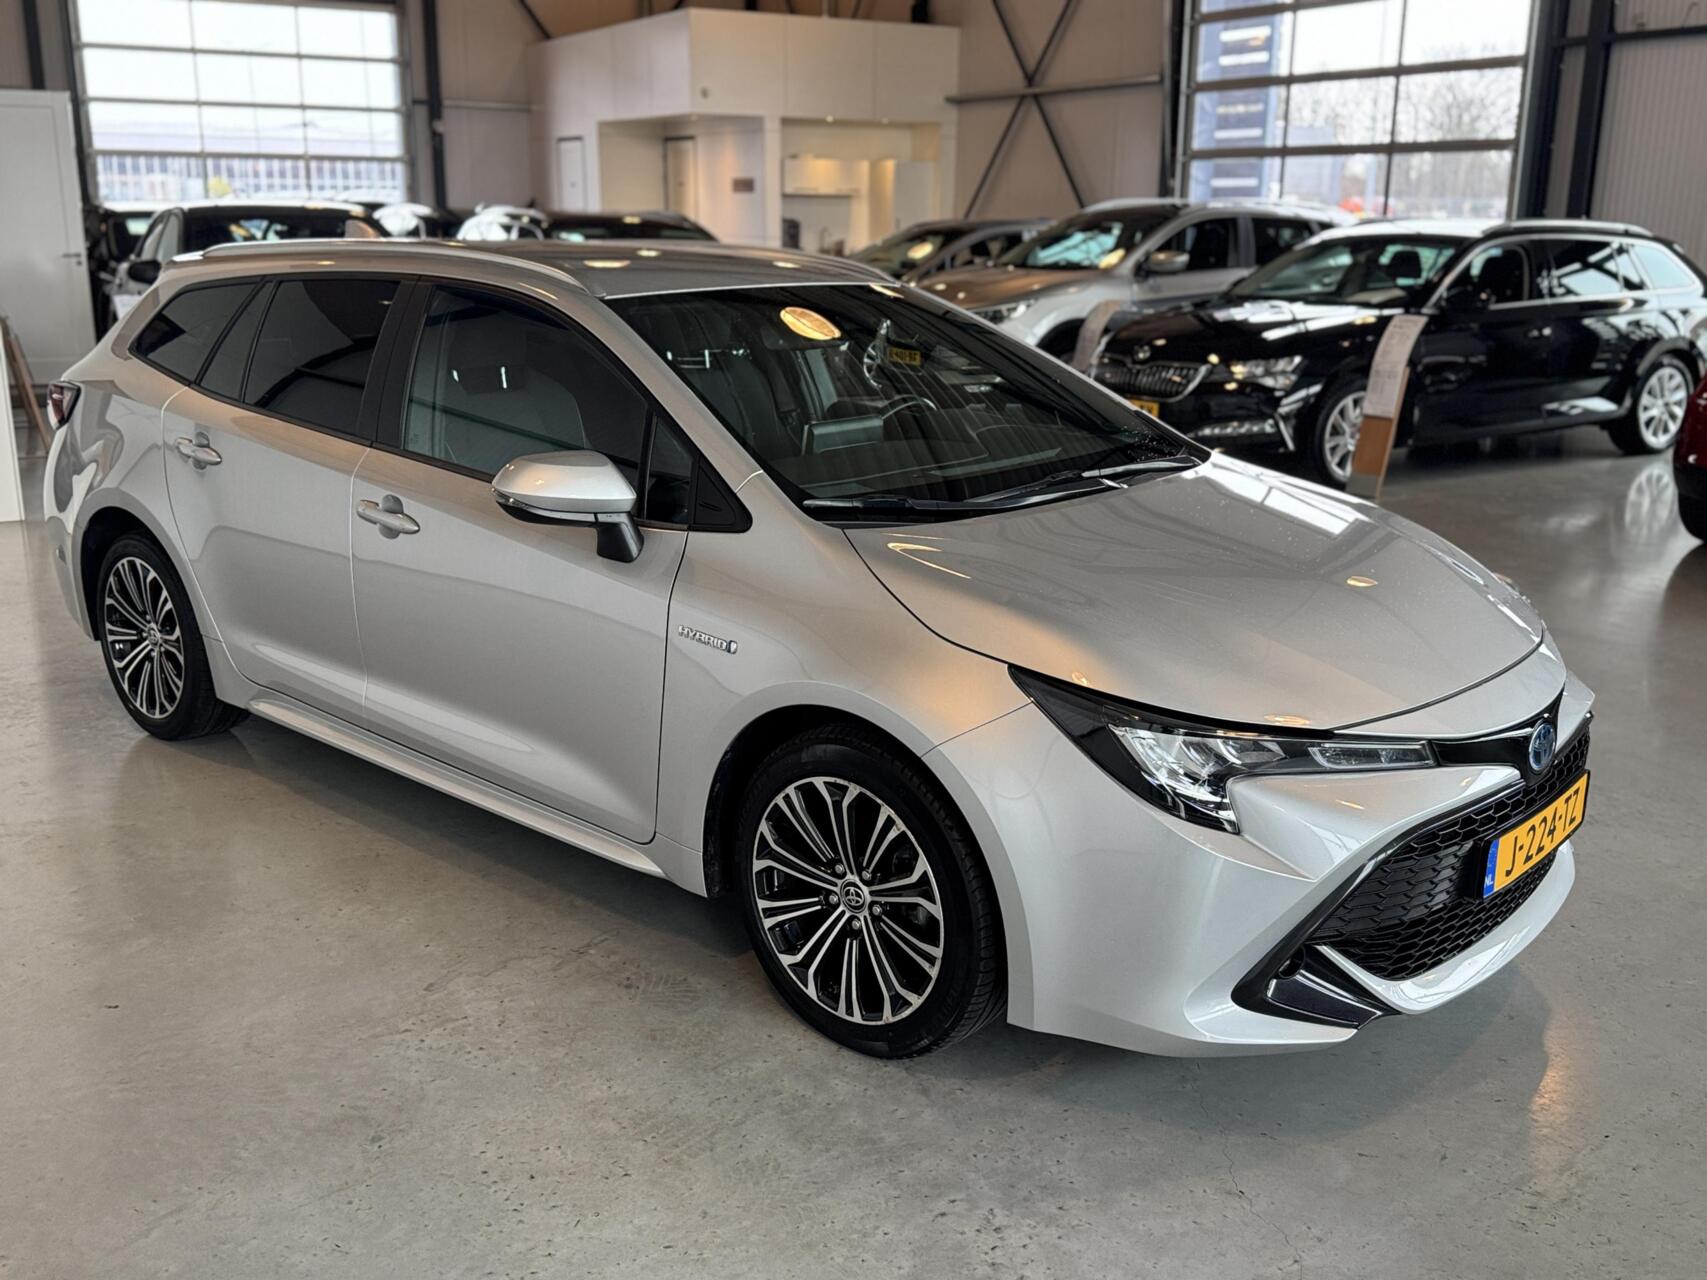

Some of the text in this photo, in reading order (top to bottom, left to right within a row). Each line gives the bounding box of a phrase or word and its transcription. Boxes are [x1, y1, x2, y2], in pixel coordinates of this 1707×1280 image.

[679, 625, 727, 650] HYBRID
[1505, 787, 1580, 877] J-224-TZ
[1484, 874, 1493, 888] NL
